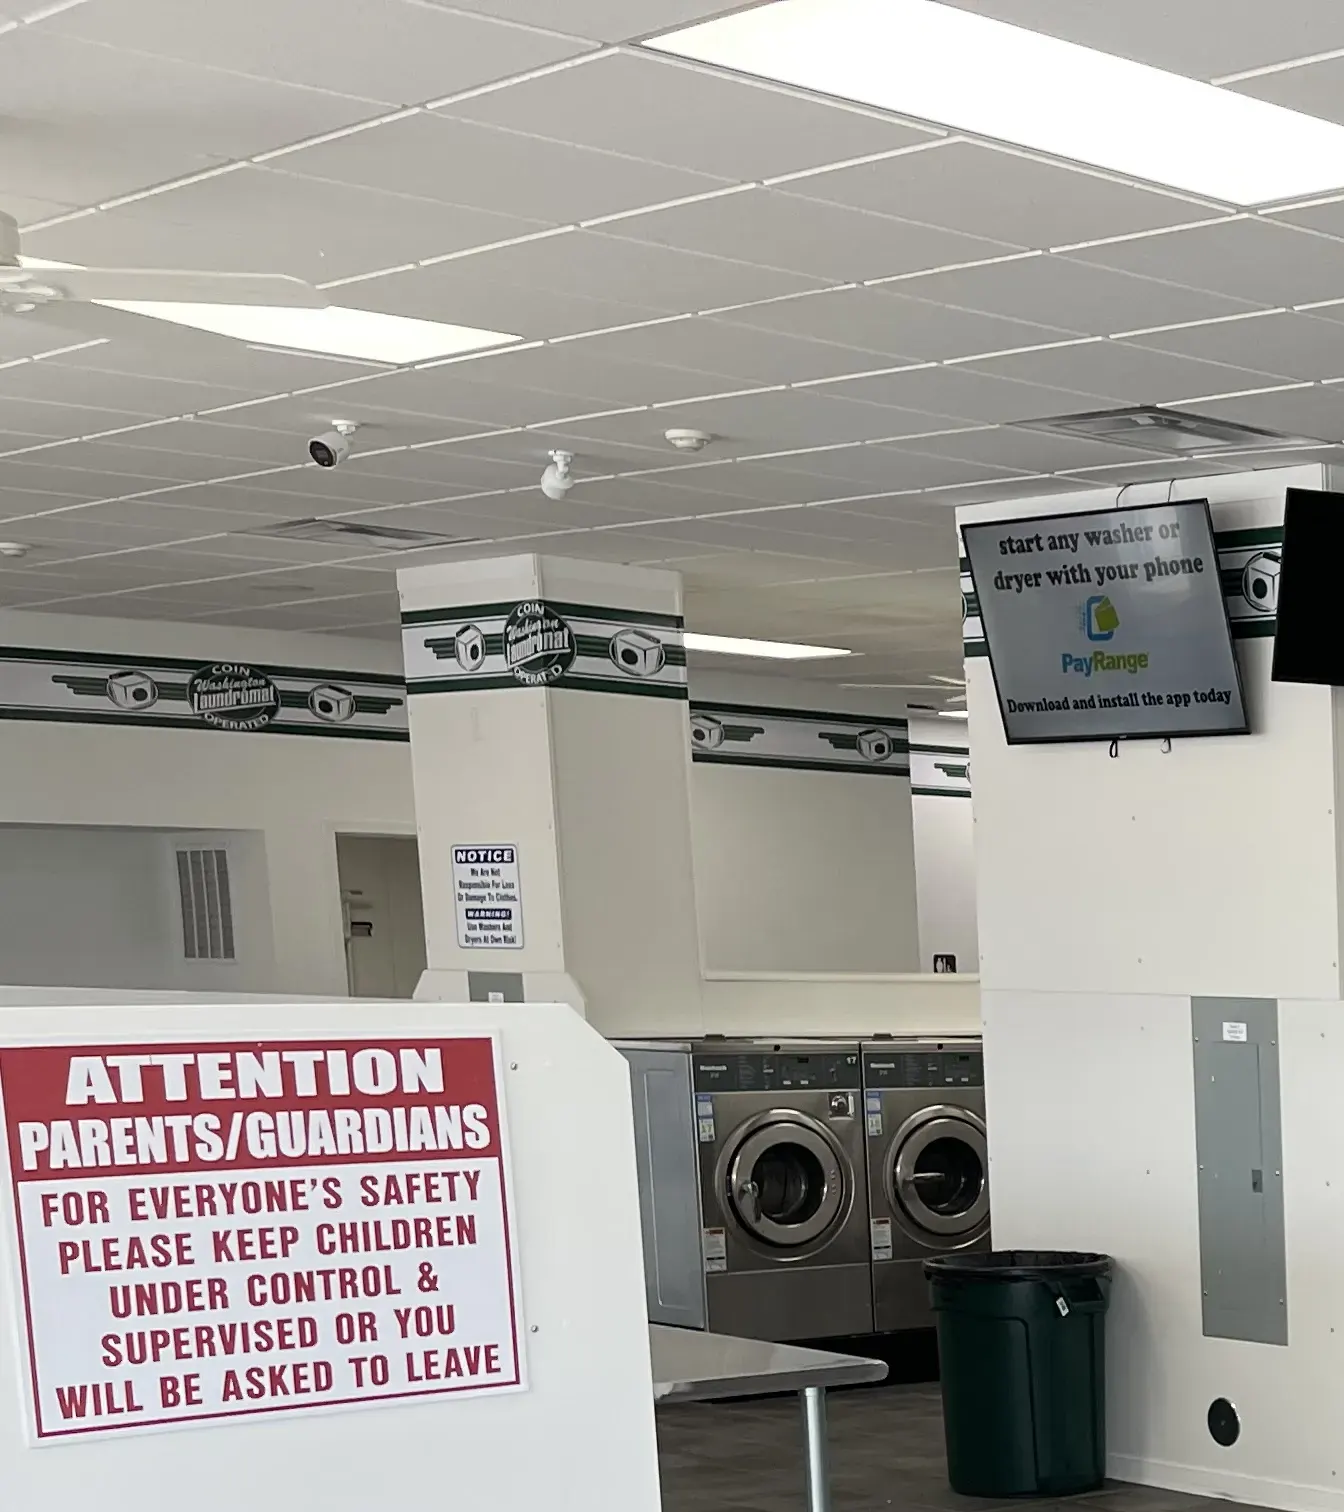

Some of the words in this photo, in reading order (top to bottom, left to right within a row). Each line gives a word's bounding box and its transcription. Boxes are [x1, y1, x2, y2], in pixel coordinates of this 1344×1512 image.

[999, 533, 1045, 555] start
[1048, 532, 1079, 553] any
[1084, 522, 1153, 546] washer
[1158, 522, 1180, 540] or
[994, 570, 1042, 594] dryer
[1046, 563, 1091, 587] with
[1094, 562, 1139, 586] your
[1143, 556, 1204, 582] phone
[517, 603, 544, 616] COIN
[212, 664, 250, 676] COIN
[1061, 650, 1149, 677] PayRange
[1007, 698, 1071, 713] Download
[1072, 694, 1096, 710] and
[1098, 692, 1138, 709] install
[1141, 692, 1163, 706] the
[1166, 694, 1191, 708] app
[1194, 688, 1232, 706] today
[205, 713, 268, 729] OPERATED
[457, 850, 512, 862] NOTICE
[467, 910, 510, 918] WARNING!
[65, 1047, 444, 1105] ATTENTION
[846, 1056, 857, 1064] 17
[18, 1104, 491, 1170] PARENTS/GUARDIANS
[41, 1191, 110, 1227] FOR
[128, 1177, 343, 1222] EVERYONE'S
[360, 1169, 482, 1208] SAFETY
[58, 1233, 195, 1275] PLEASE
[212, 1225, 300, 1263] KEEP
[316, 1214, 477, 1256] CHILDREN
[109, 1279, 230, 1318] UNDER
[246, 1265, 402, 1307] CONTROL
[417, 1261, 439, 1292] &
[101, 1316, 318, 1367] SUPERVISED
[336, 1310, 378, 1345] OR
[393, 1304, 456, 1339] YOU
[55, 1379, 143, 1419] WILL
[160, 1373, 202, 1408] BE
[222, 1360, 334, 1402] ASKED
[348, 1355, 390, 1389] TO
[406, 1344, 501, 1382] LEAVE
